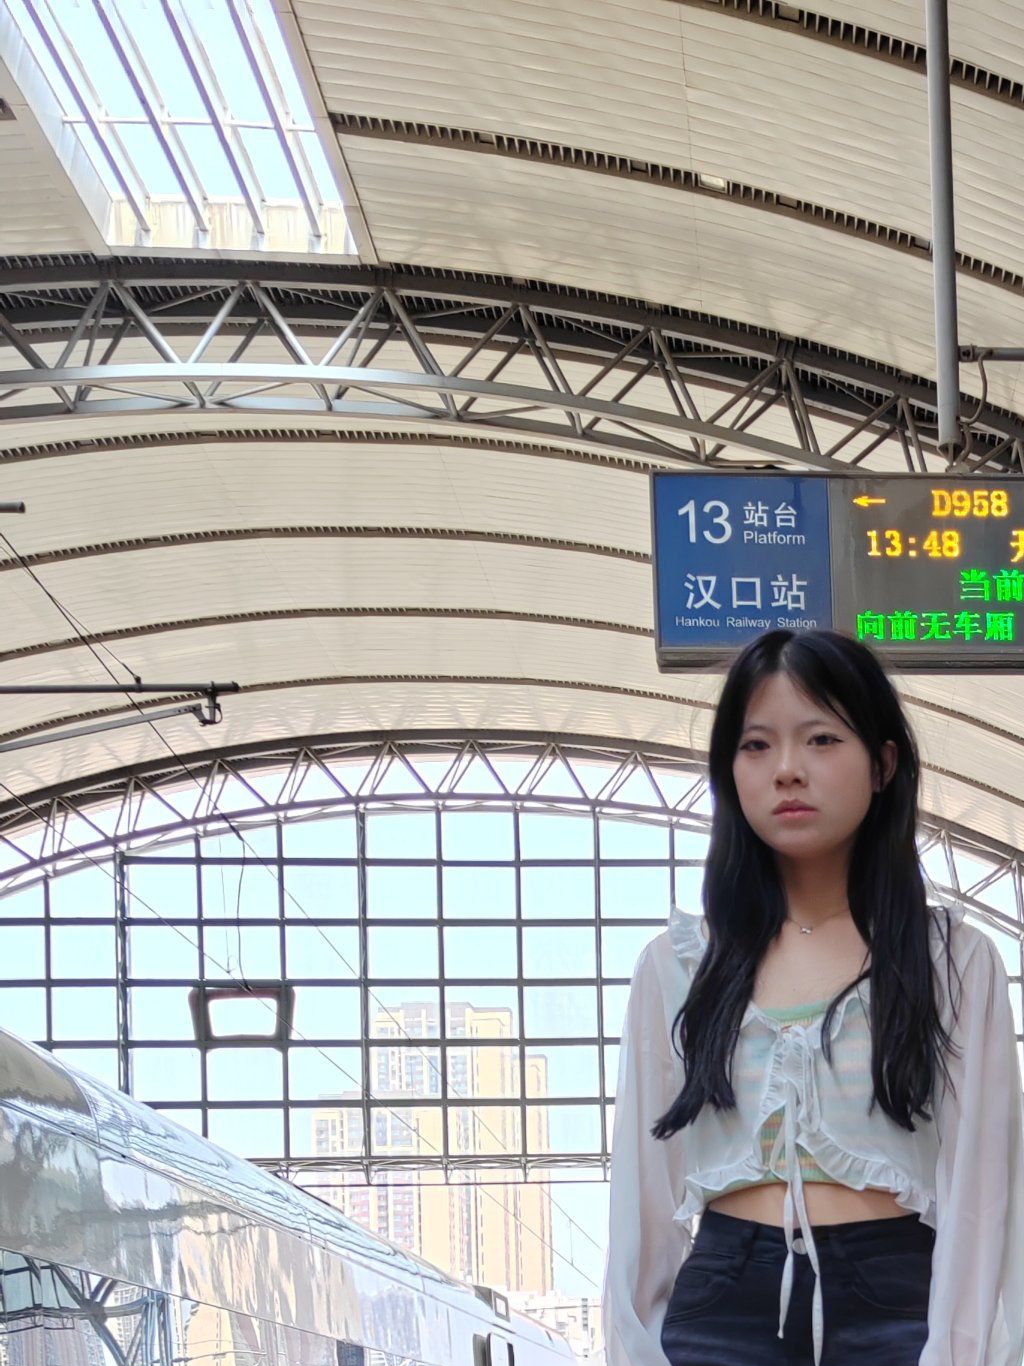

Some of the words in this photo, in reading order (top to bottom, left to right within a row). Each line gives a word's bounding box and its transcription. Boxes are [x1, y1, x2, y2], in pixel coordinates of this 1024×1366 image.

[931, 489, 1009, 517] D958
[677, 499, 733, 544] 13
[743, 501, 798, 528] 站台
[743, 530, 806, 545] Platform
[867, 530, 961, 558] 13:48
[684, 573, 808, 611] 汉口站
[675, 616, 720, 627] Hankou
[726, 616, 771, 629] Railway
[777, 616, 817, 628] Station
[857, 610, 1014, 640] 向前无车厢
